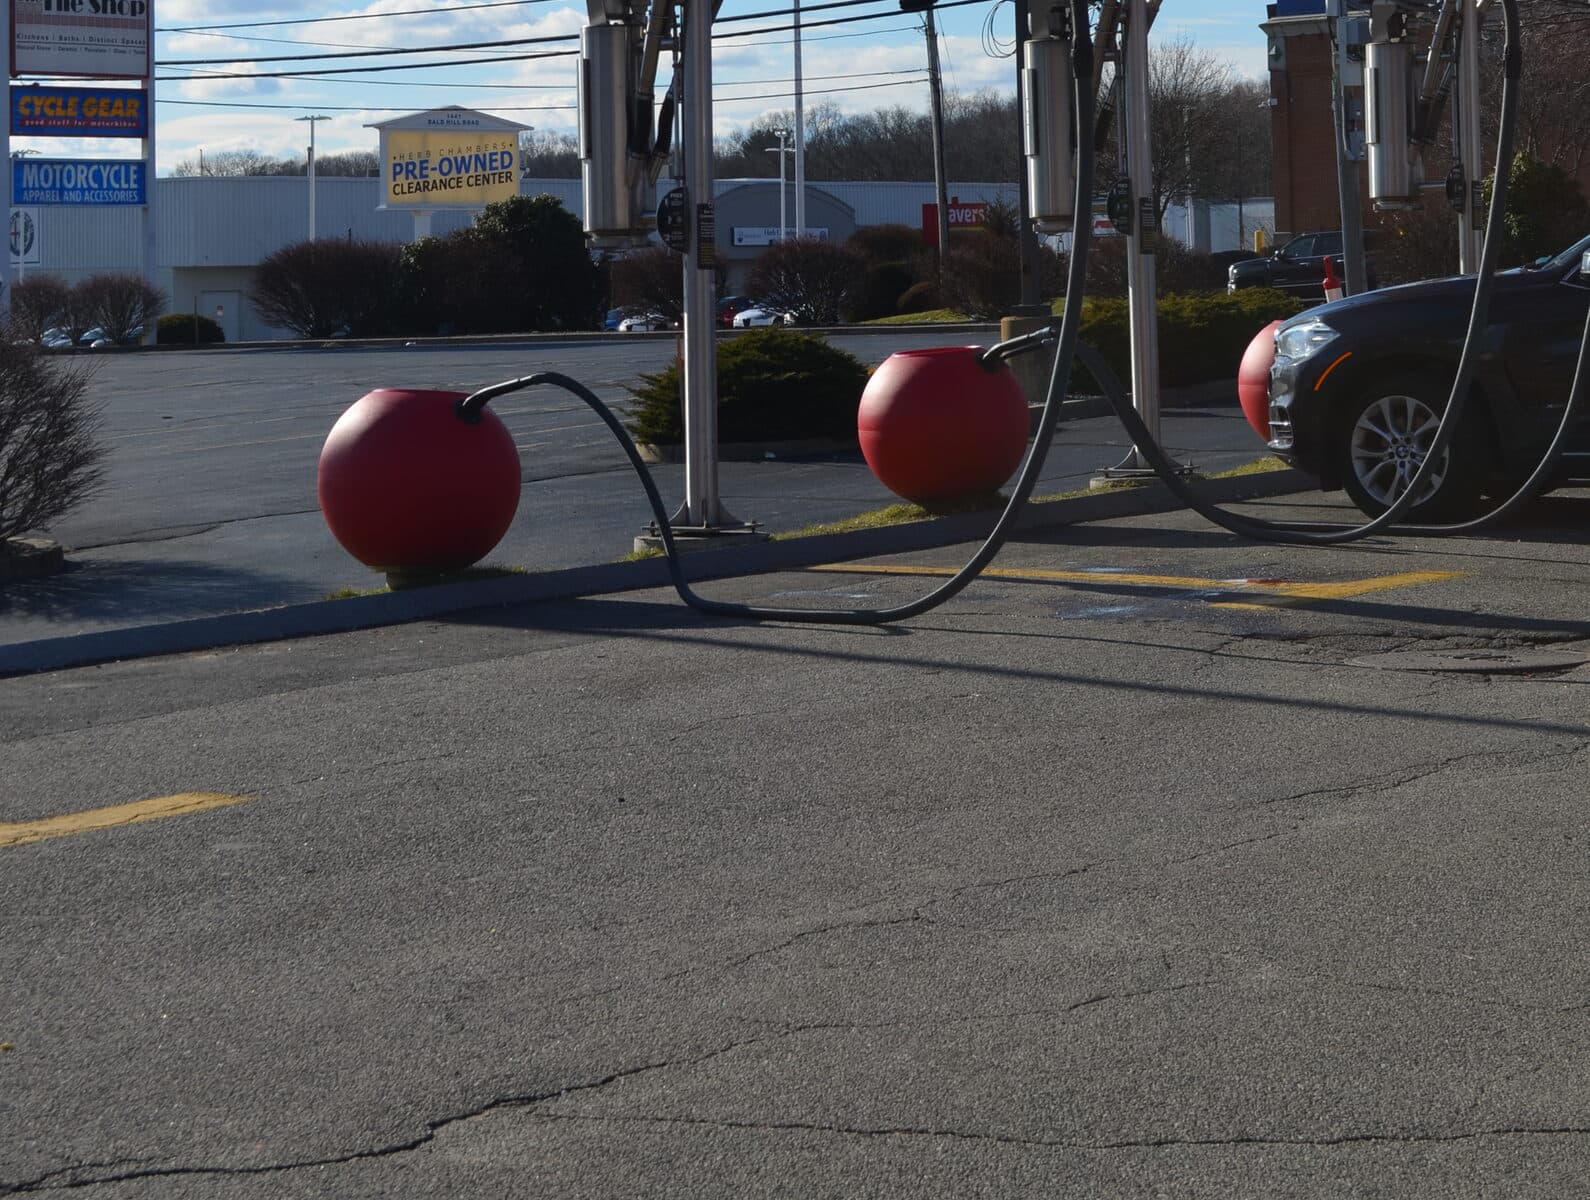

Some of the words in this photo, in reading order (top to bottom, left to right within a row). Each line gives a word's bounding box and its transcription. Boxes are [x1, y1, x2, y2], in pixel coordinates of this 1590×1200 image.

[18, 95, 79, 117] CYCLE
[82, 96, 140, 118] GEAR
[439, 142, 507, 157] CHAMBERS
[23, 164, 138, 189] MOTORCYCLE
[392, 150, 514, 182] PRE-OWNED
[392, 176, 463, 196] CLEARANCE
[466, 171, 513, 187] CENTER
[23, 190, 60, 201] APPAREL
[63, 190, 82, 202] AND
[84, 190, 138, 202] ACCESSORIES
